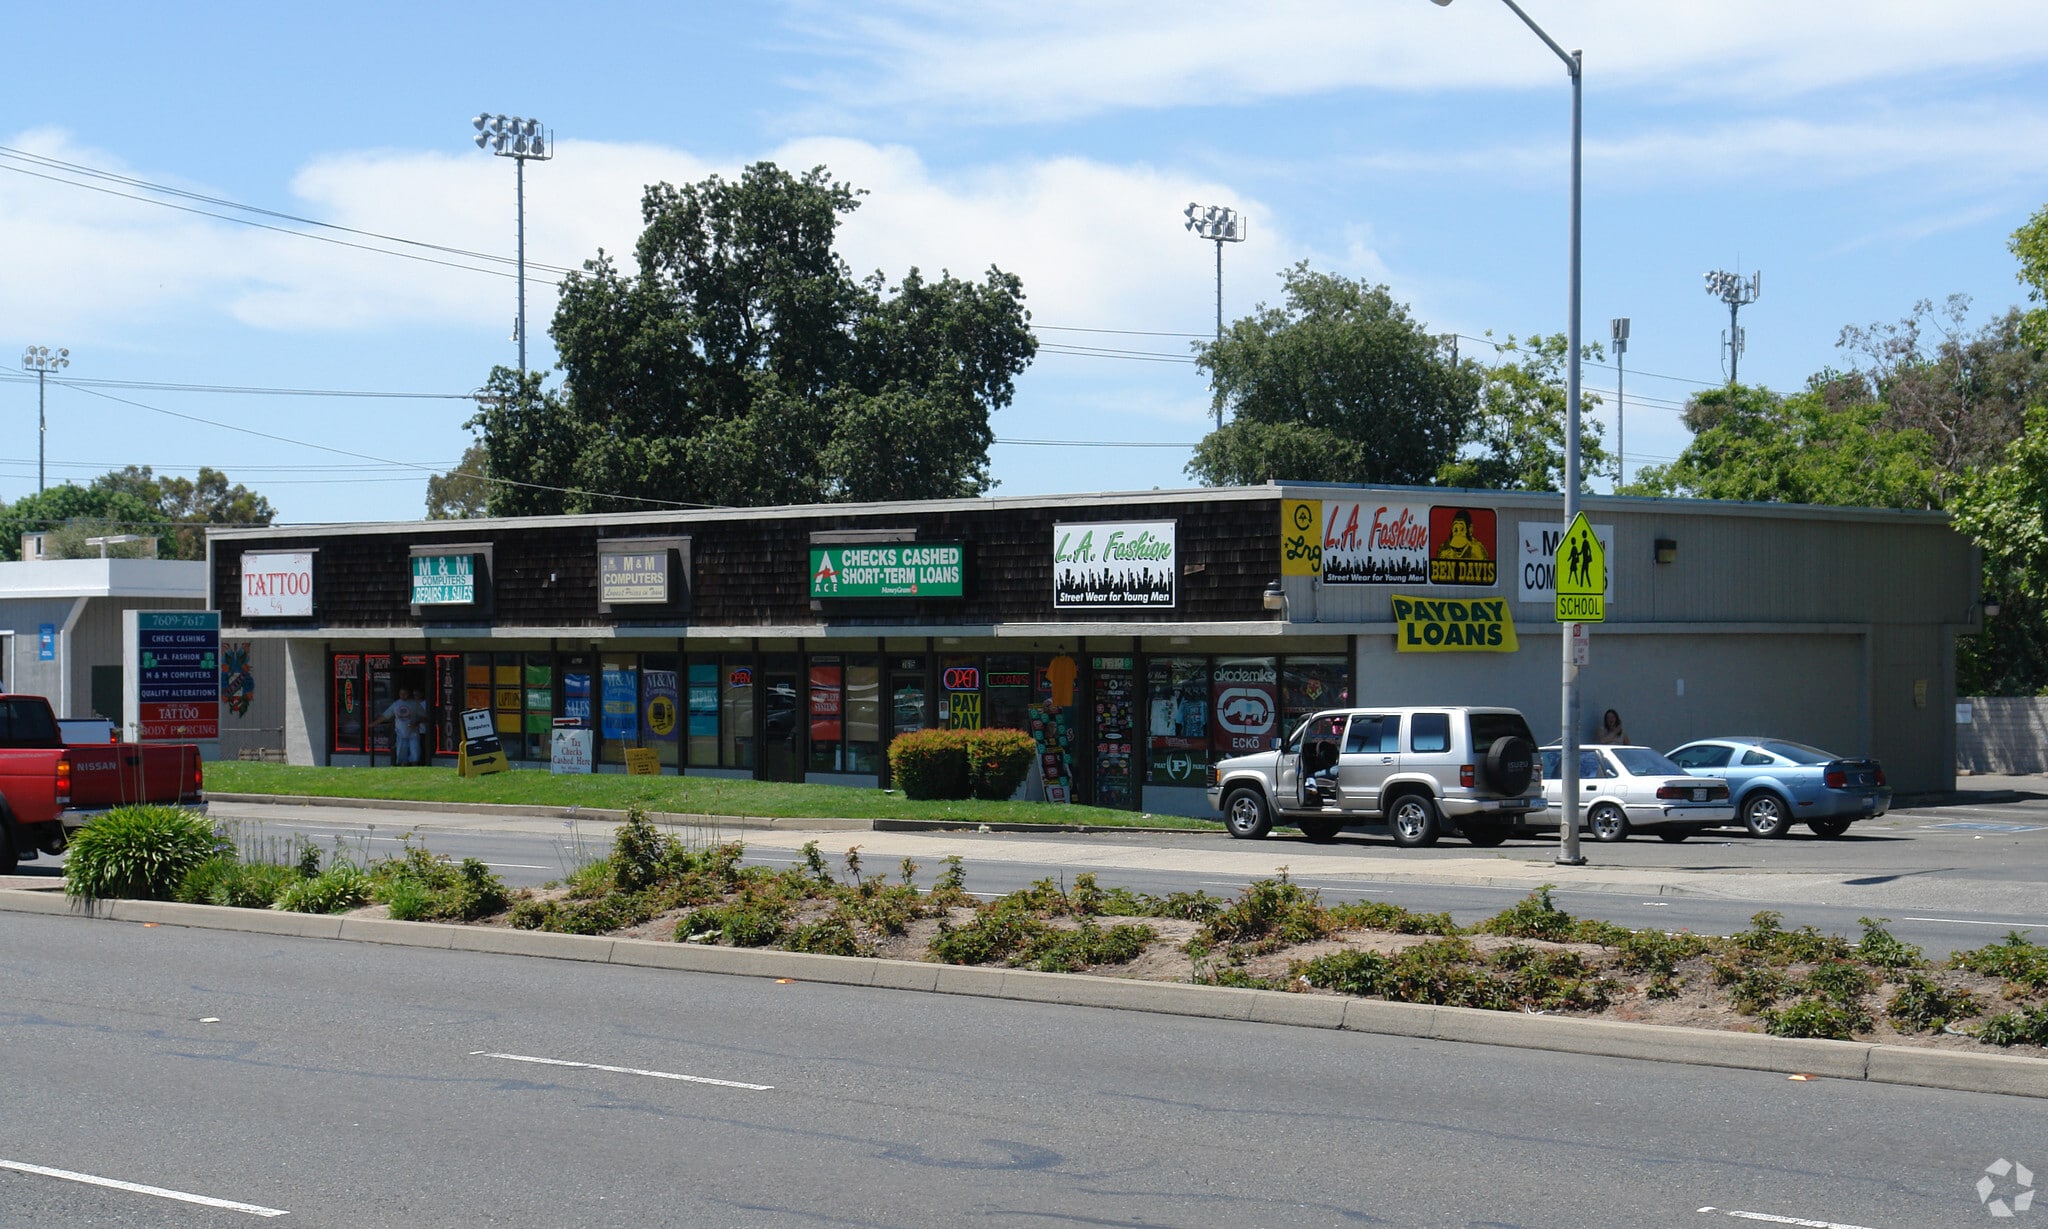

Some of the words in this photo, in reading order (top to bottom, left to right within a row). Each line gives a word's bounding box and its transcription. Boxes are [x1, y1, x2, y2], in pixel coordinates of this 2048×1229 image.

[1324, 504, 1362, 553] L.A.
[1370, 506, 1429, 553] Fashion
[1055, 530, 1096, 564] L.A.
[1103, 530, 1173, 563] Fashion
[623, 556, 634, 571] M
[635, 559, 642, 569] &
[644, 556, 655, 571] M
[842, 549, 897, 567] CHECKS
[902, 548, 959, 566] CASHED
[418, 557, 431, 577] M
[438, 557, 448, 577] &
[455, 556, 469, 576] M
[1431, 560, 1456, 581] BEN
[1460, 561, 1496, 582] DAVIS
[421, 576, 467, 586] COMPUTERS
[603, 572, 664, 585] COMPUTERS
[842, 567, 916, 585] SHORT-TERM
[919, 566, 959, 584] LOANS
[1327, 574, 1350, 582] Street
[1351, 574, 1371, 583] Wear
[1372, 574, 1384, 583] for
[1385, 574, 1407, 585] Young
[1409, 574, 1425, 583] Men
[244, 572, 310, 597] TATTOO
[814, 584, 838, 592] ACE
[416, 587, 442, 602] REPAIRS
[452, 586, 472, 601] SALES
[1060, 592, 1084, 602] Street
[1086, 592, 1107, 602] Wear
[1109, 592, 1121, 602] for
[1123, 592, 1149, 604] Young
[1150, 592, 1170, 602] Men
[1394, 600, 1504, 622] PAYDAY
[1560, 598, 1600, 615] SCHOOL
[152, 615, 205, 626] 7609-7617
[152, 635, 174, 643] CHECK
[177, 635, 206, 643] CASHING
[1407, 623, 1504, 646] LOANS
[146, 671, 151, 679] M
[162, 671, 168, 679] M
[171, 671, 211, 679] COMPUTERS
[729, 672, 751, 683] OPEN
[946, 669, 979, 689] OPEN
[990, 676, 1029, 686] LOANS
[141, 690, 169, 698] QUALITY
[171, 689, 216, 697] ALTERATIONS
[565, 699, 590, 717] SALES
[952, 694, 979, 712] PAY
[159, 708, 199, 719] TATTOO
[952, 713, 979, 730] DAY
[142, 725, 168, 736] BODY
[562, 747, 583, 756] Checks
[77, 761, 116, 771] NISSAN
[553, 756, 573, 765] Cashed
[576, 757, 590, 766] Here
